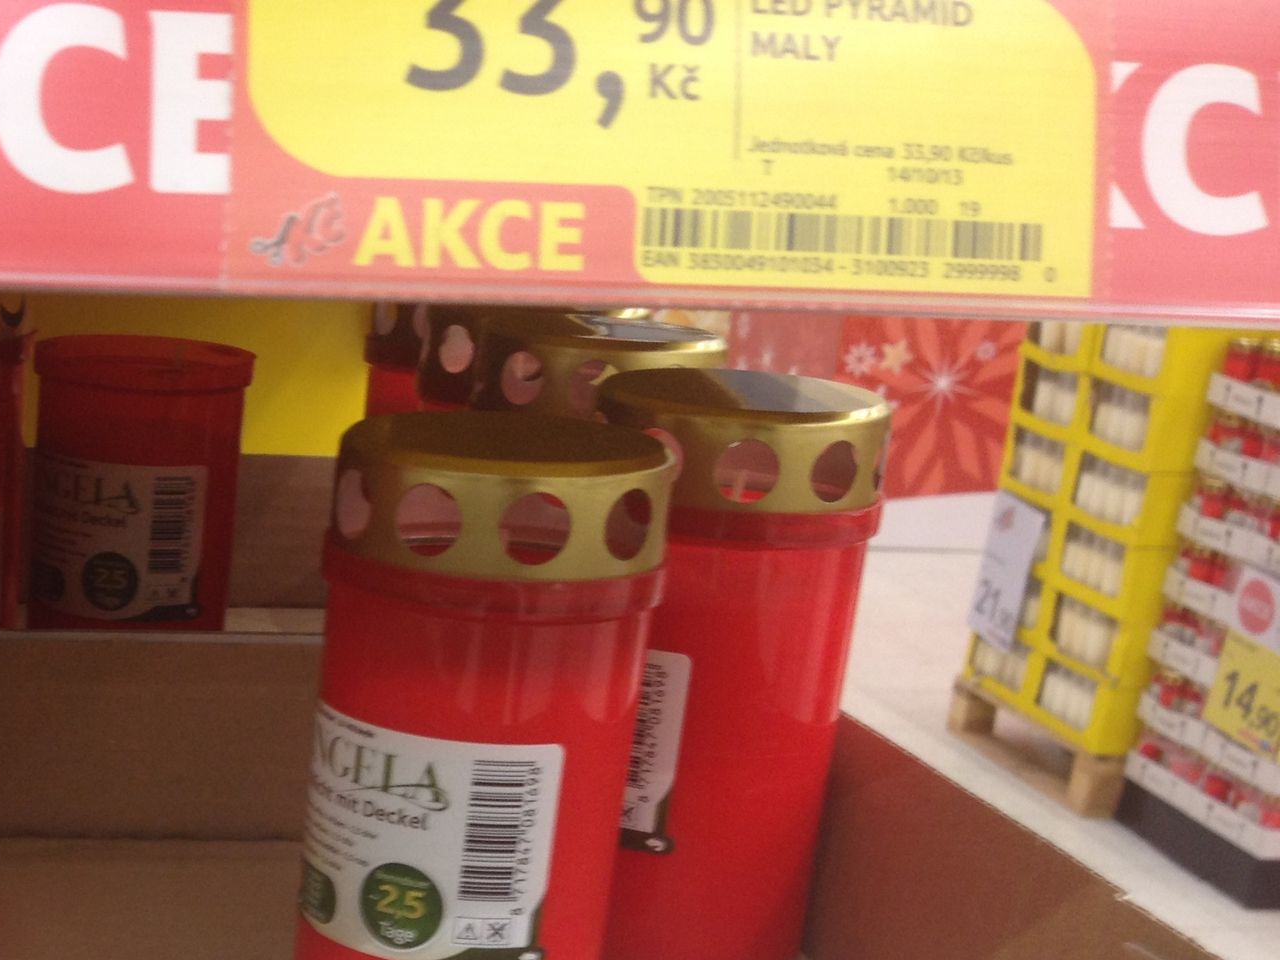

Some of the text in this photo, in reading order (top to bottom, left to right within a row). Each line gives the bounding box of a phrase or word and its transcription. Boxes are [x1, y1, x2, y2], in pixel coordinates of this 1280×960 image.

[632, 0, 716, 46] 90
[751, 30, 842, 62] MALY
[352, 195, 587, 273] AKCE
[362, 799, 429, 831] Deckel
[377, 920, 419, 945] Tage
